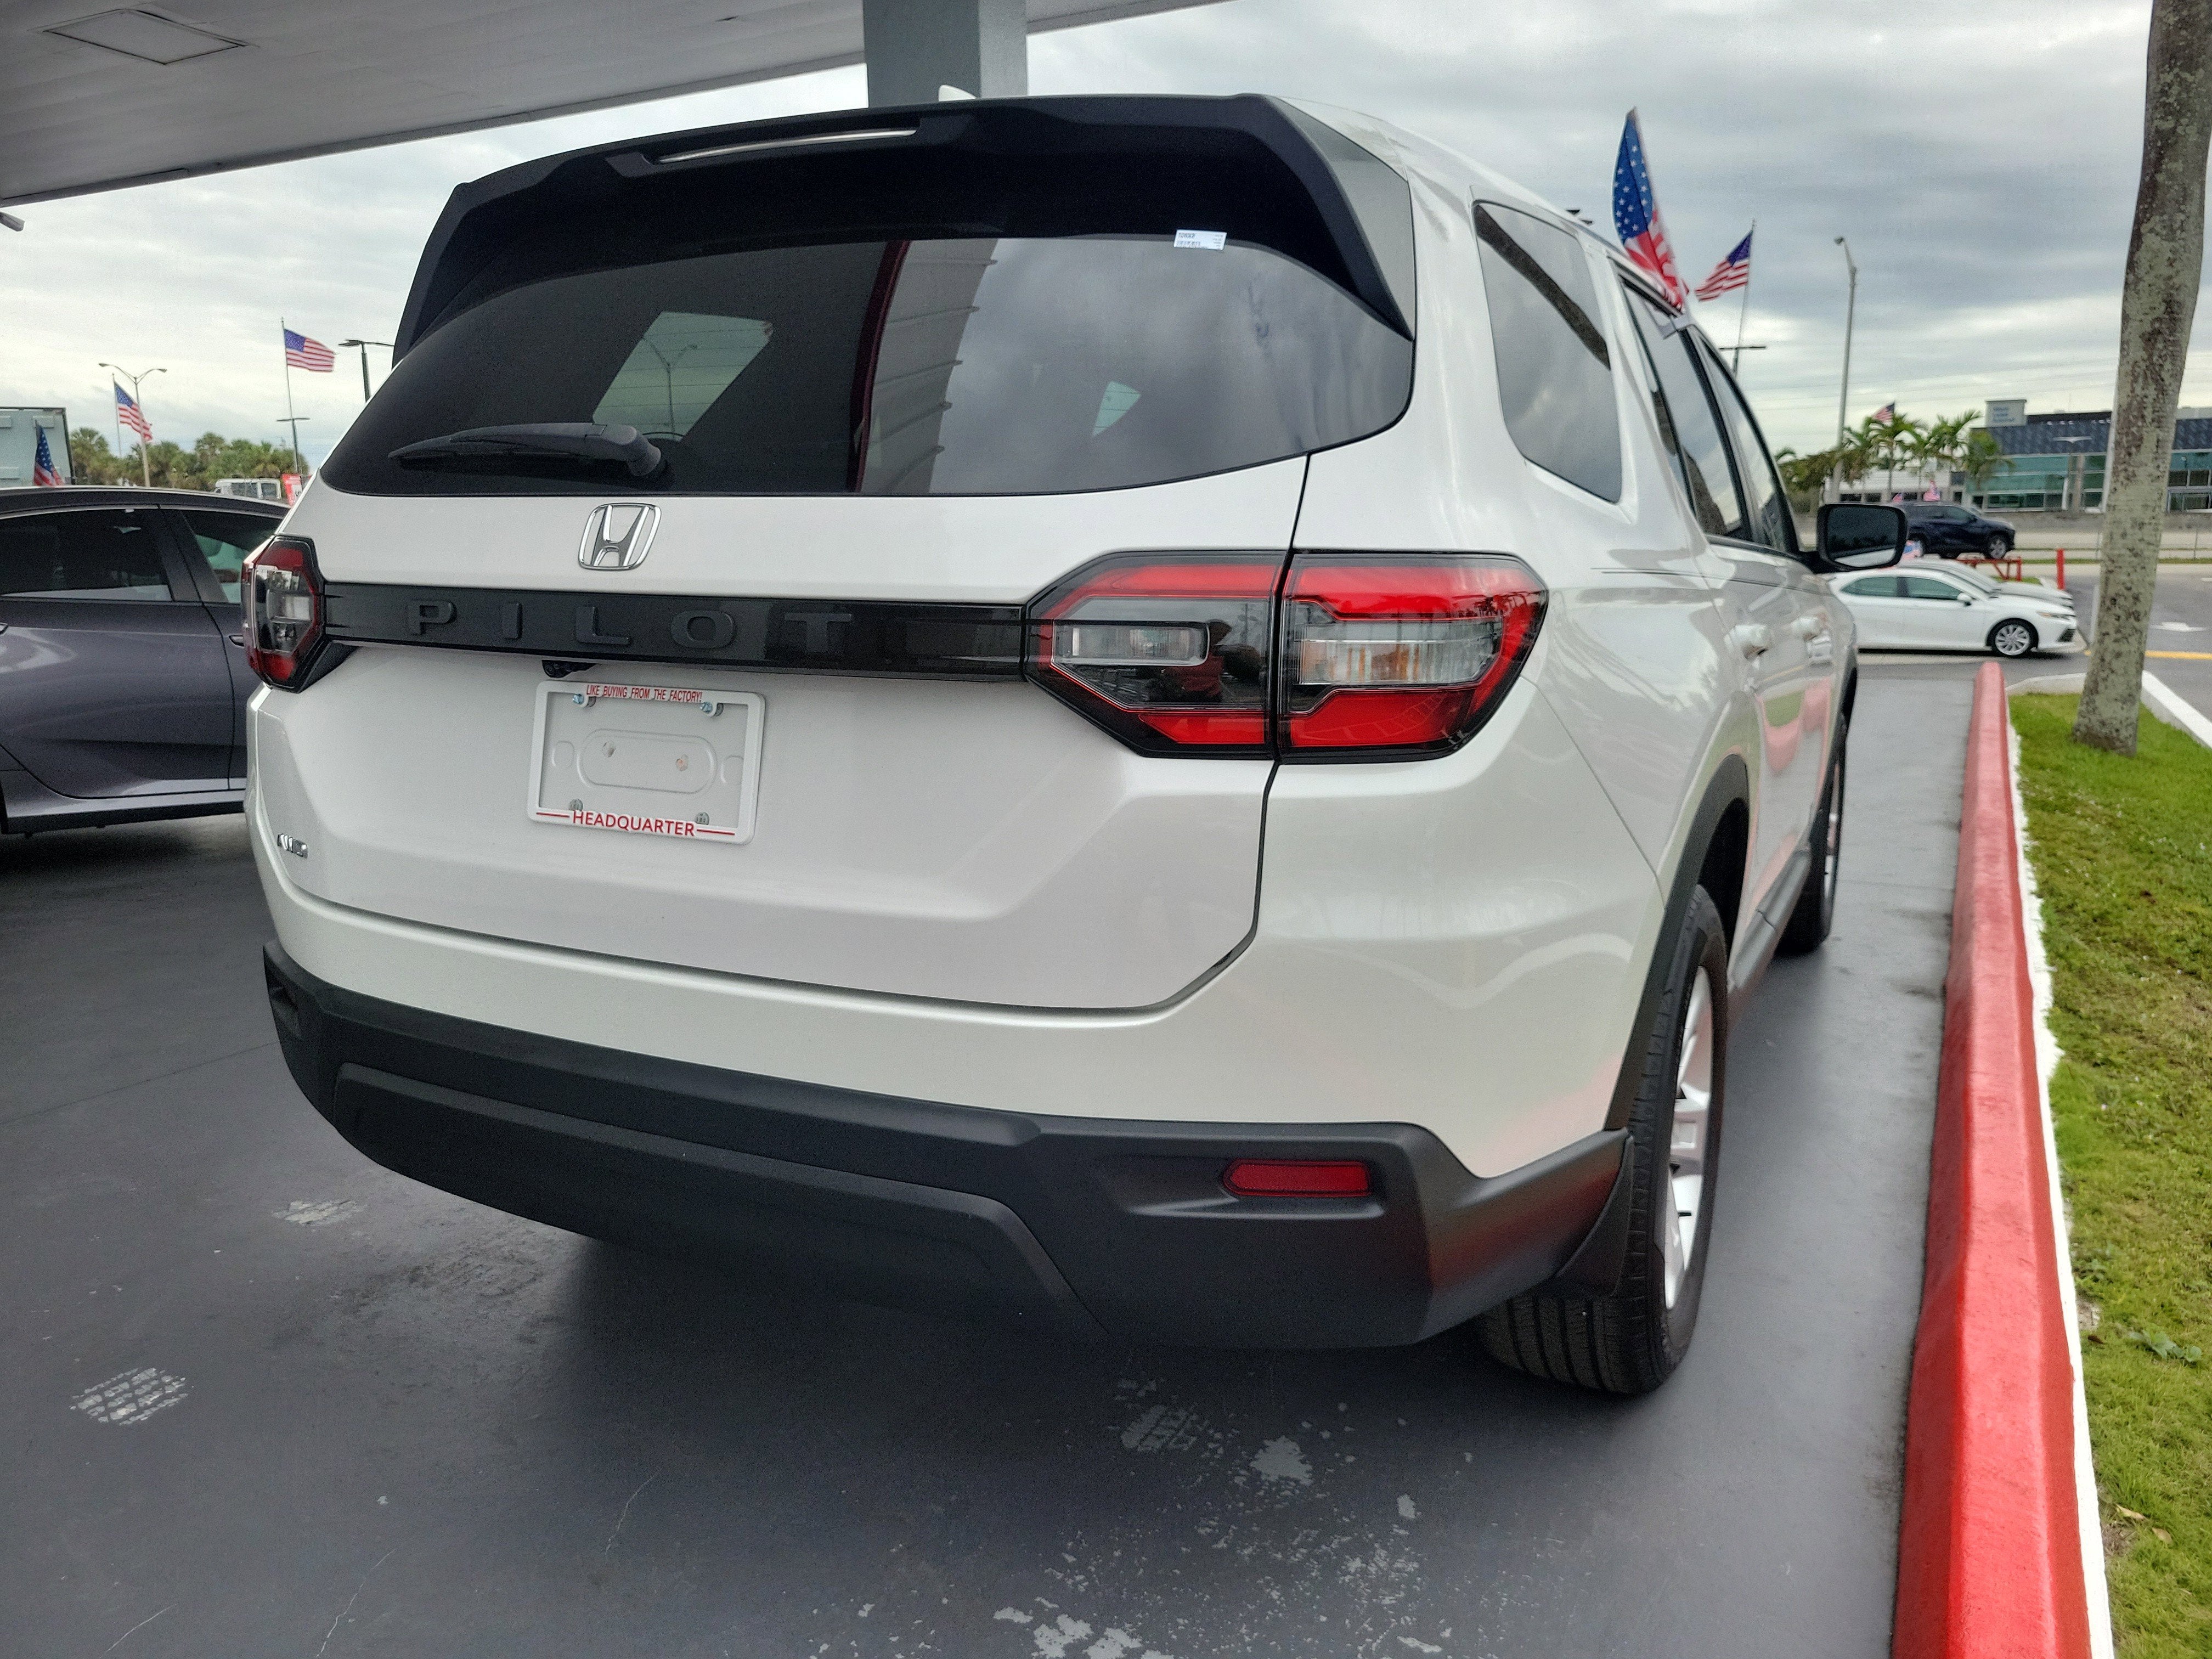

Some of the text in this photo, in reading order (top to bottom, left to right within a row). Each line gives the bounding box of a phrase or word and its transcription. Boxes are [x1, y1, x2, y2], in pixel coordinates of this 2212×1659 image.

[407, 600, 854, 653] PILOT
[586, 685, 703, 702] LIKE BUYING FROM THE FACTORY!
[573, 810, 695, 837] HEADQUARTER
